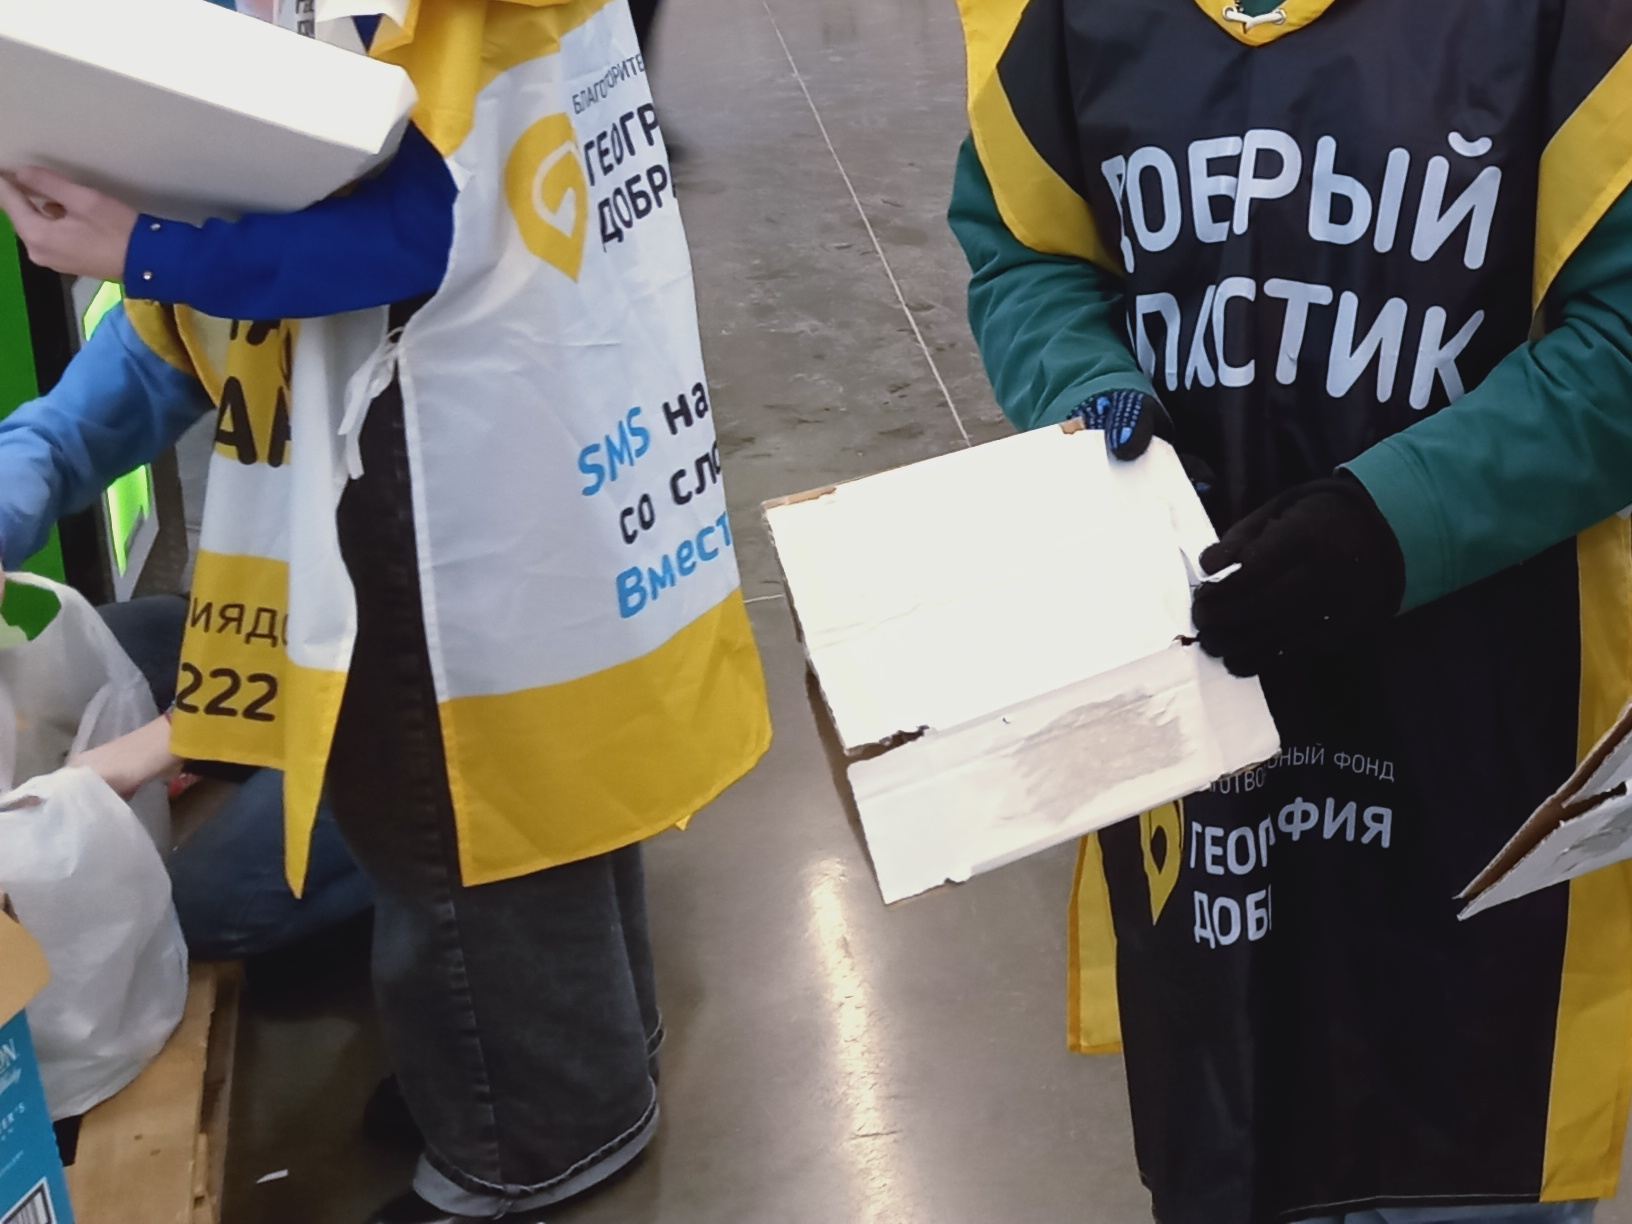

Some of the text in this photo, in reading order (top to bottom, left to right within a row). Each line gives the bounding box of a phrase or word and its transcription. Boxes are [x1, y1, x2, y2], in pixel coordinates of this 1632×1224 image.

[598, 164, 677, 252] ДОБР
[577, 382, 709, 496] SMS на
[620, 493, 656, 545] со
[1334, 751, 1394, 782] ФОНД
